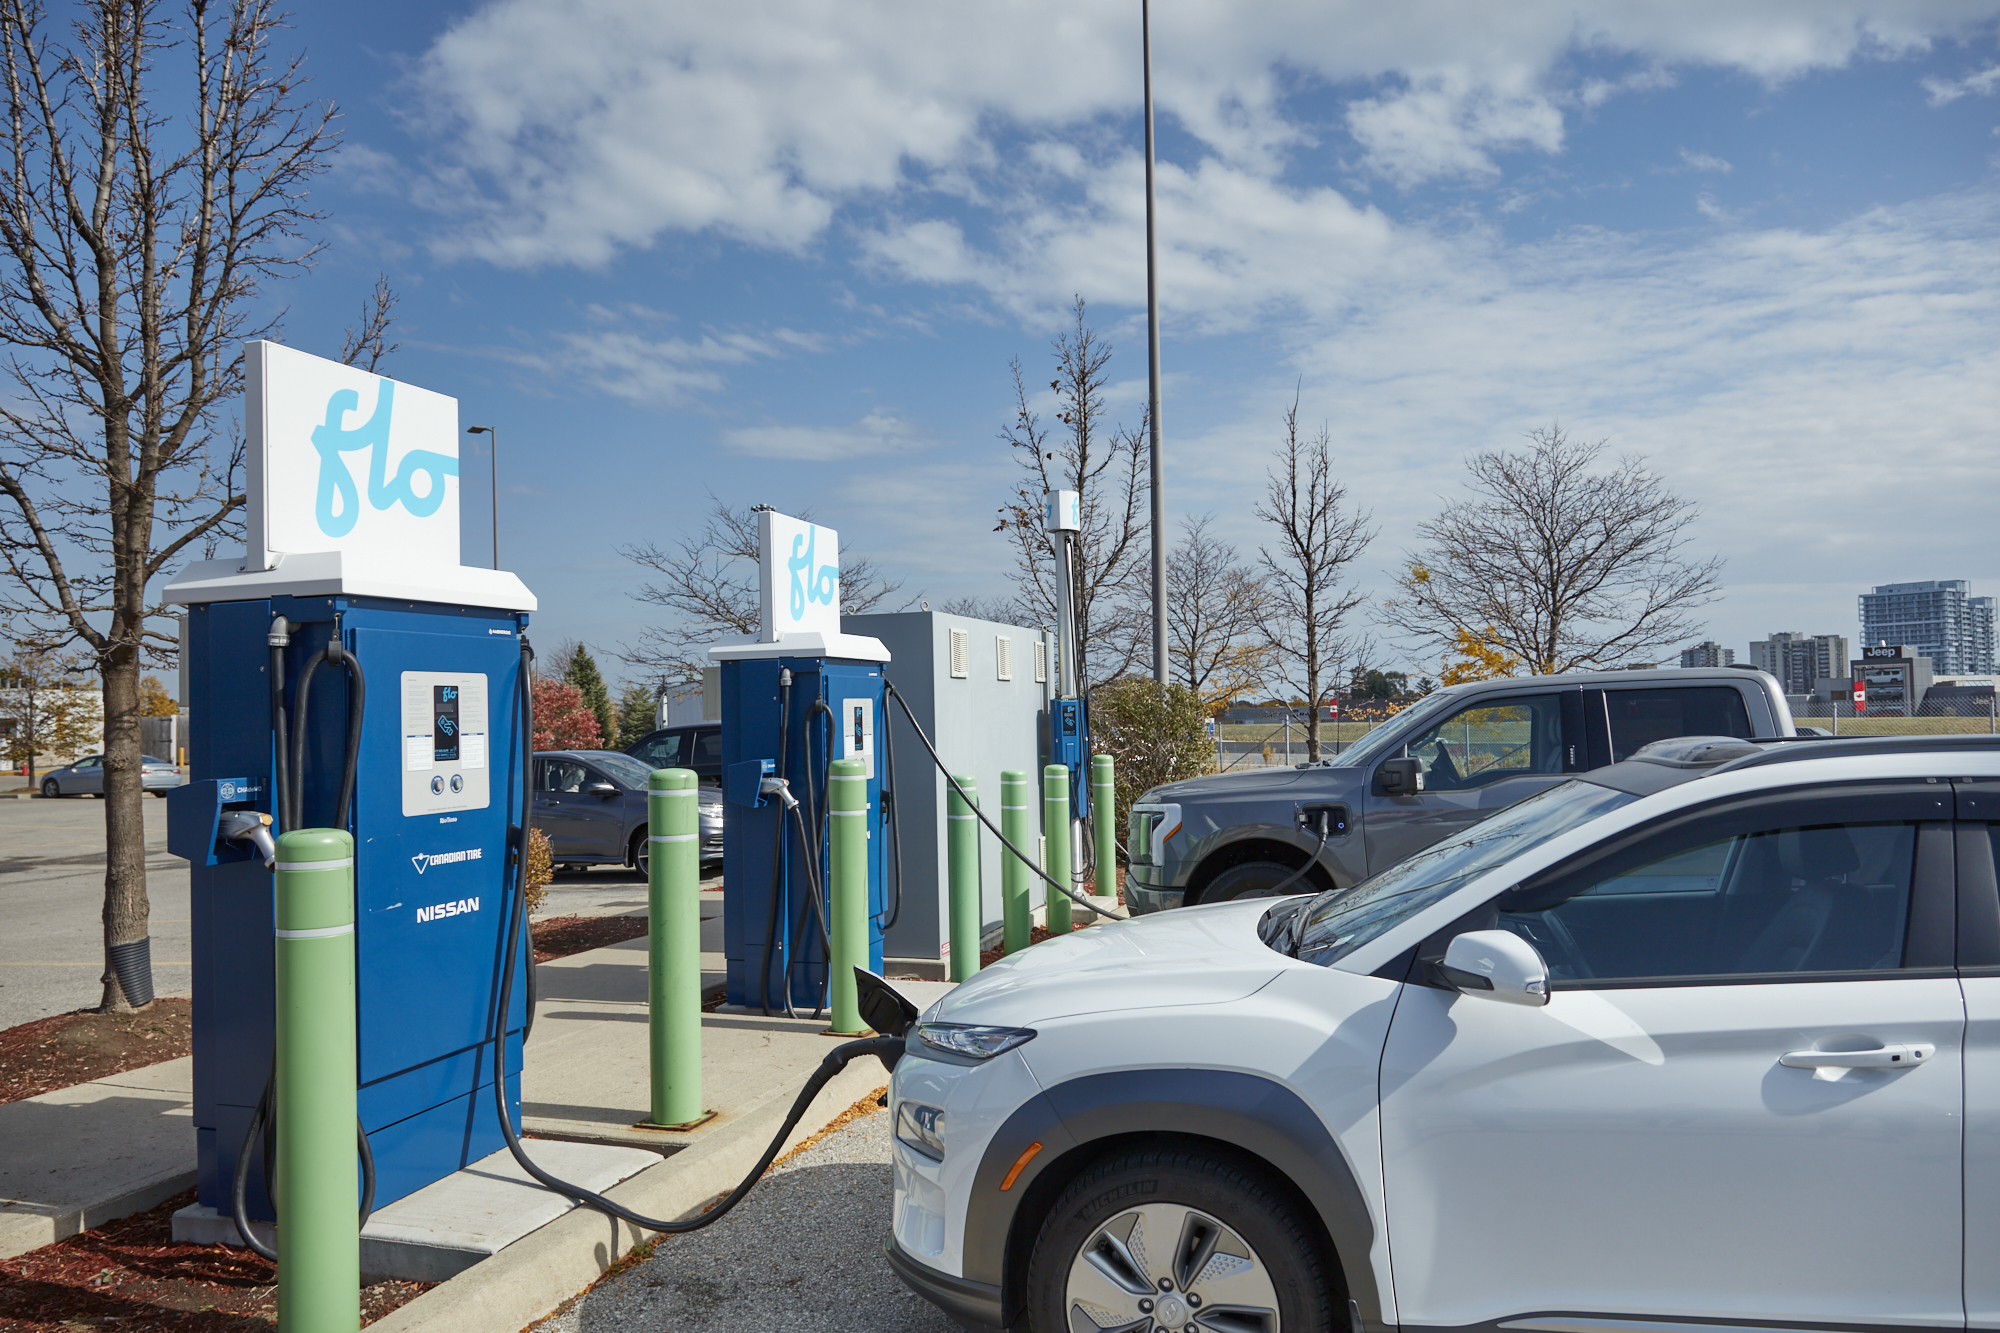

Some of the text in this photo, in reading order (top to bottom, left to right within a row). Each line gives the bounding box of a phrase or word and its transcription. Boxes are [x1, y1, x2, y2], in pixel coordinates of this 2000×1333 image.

[310, 378, 459, 538] flo
[788, 524, 839, 622] flo
[1867, 647, 1896, 658] Jeep
[442, 686, 458, 703] flo
[1972, 697, 1990, 705] Jee
[430, 848, 482, 866] CANADIAN TIRE
[416, 896, 480, 924] NISSAN
[1081, 1180, 1157, 1219] MICHELIN
